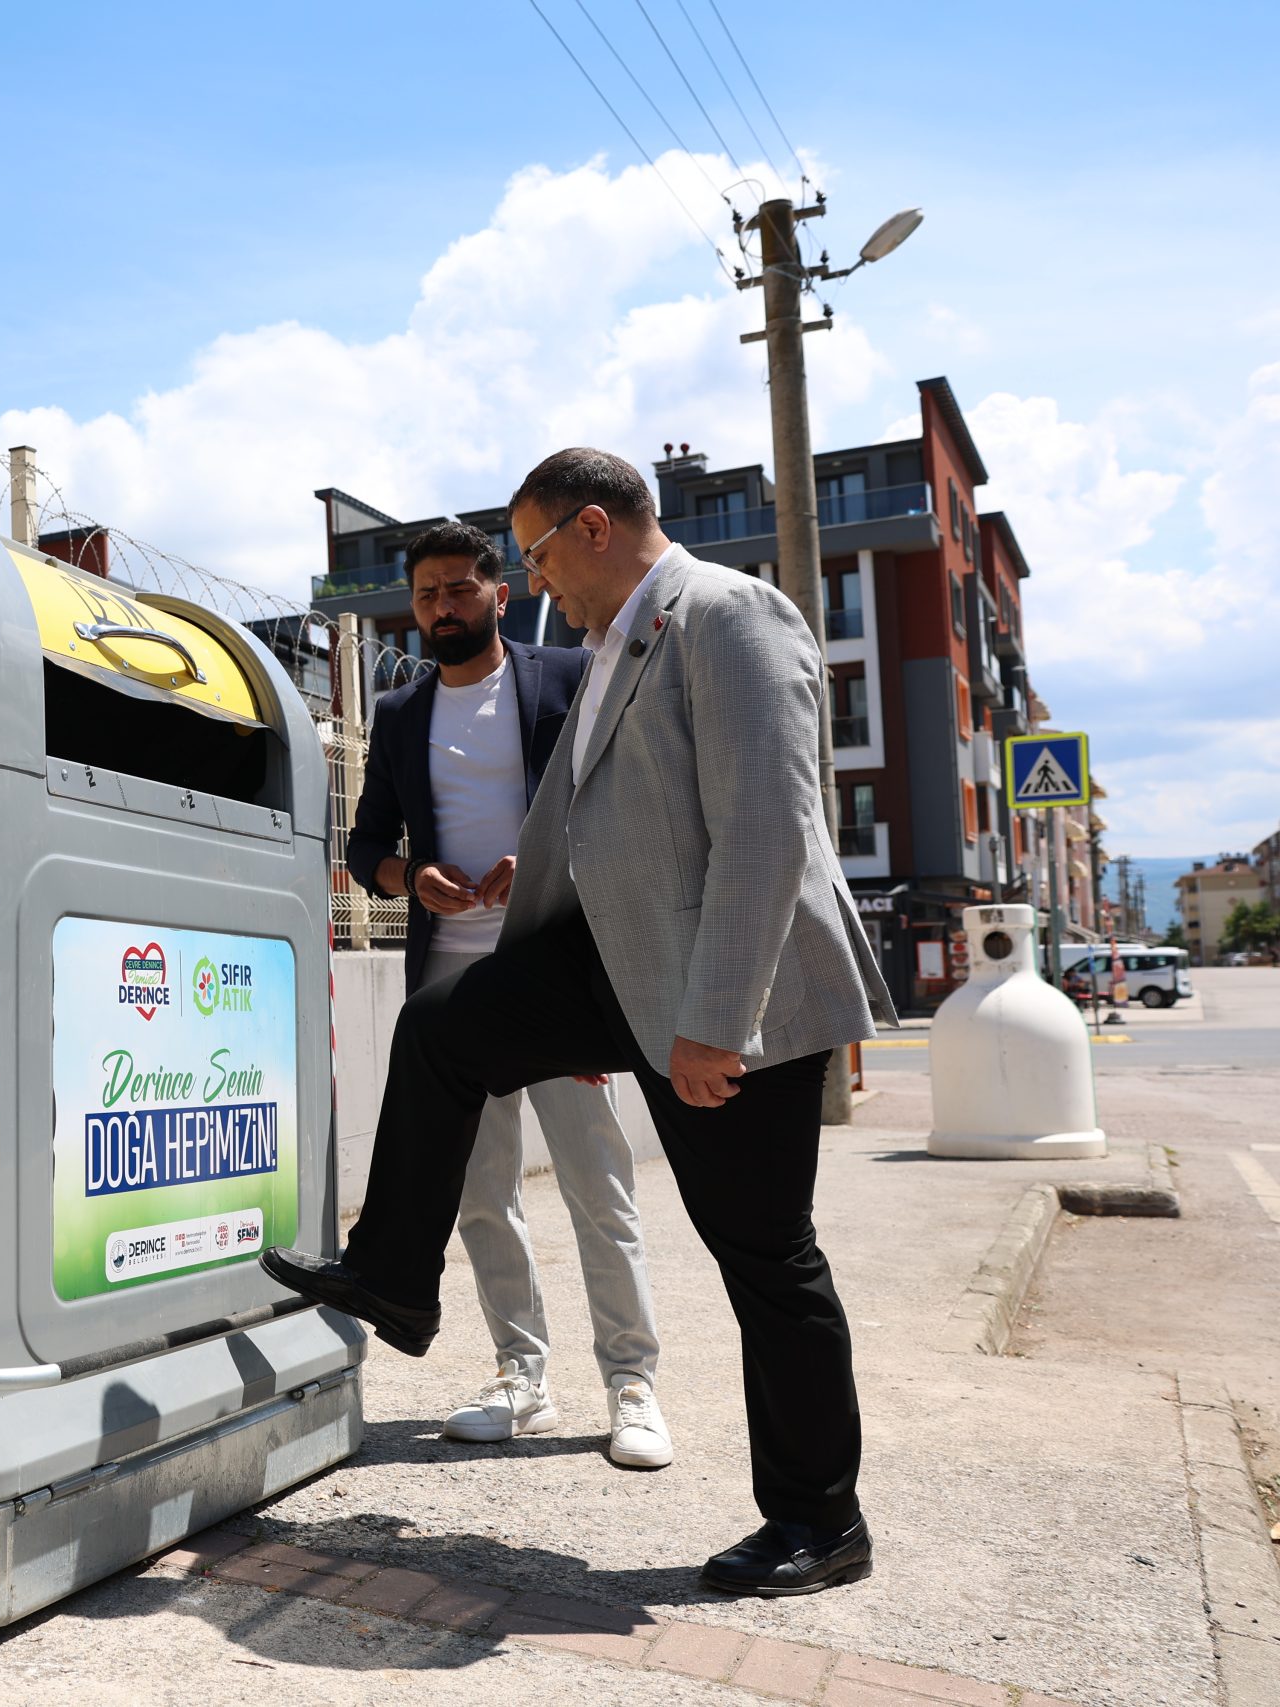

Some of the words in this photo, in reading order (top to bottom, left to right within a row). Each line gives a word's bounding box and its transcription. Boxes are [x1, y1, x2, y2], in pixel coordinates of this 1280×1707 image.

[855, 897, 894, 912] ACI
[222, 963, 252, 986] SIFIR
[222, 988, 253, 1012] ATIK
[102, 1049, 197, 1109] Derince
[203, 1048, 265, 1104] Senin
[88, 1111, 158, 1190] DOĞA
